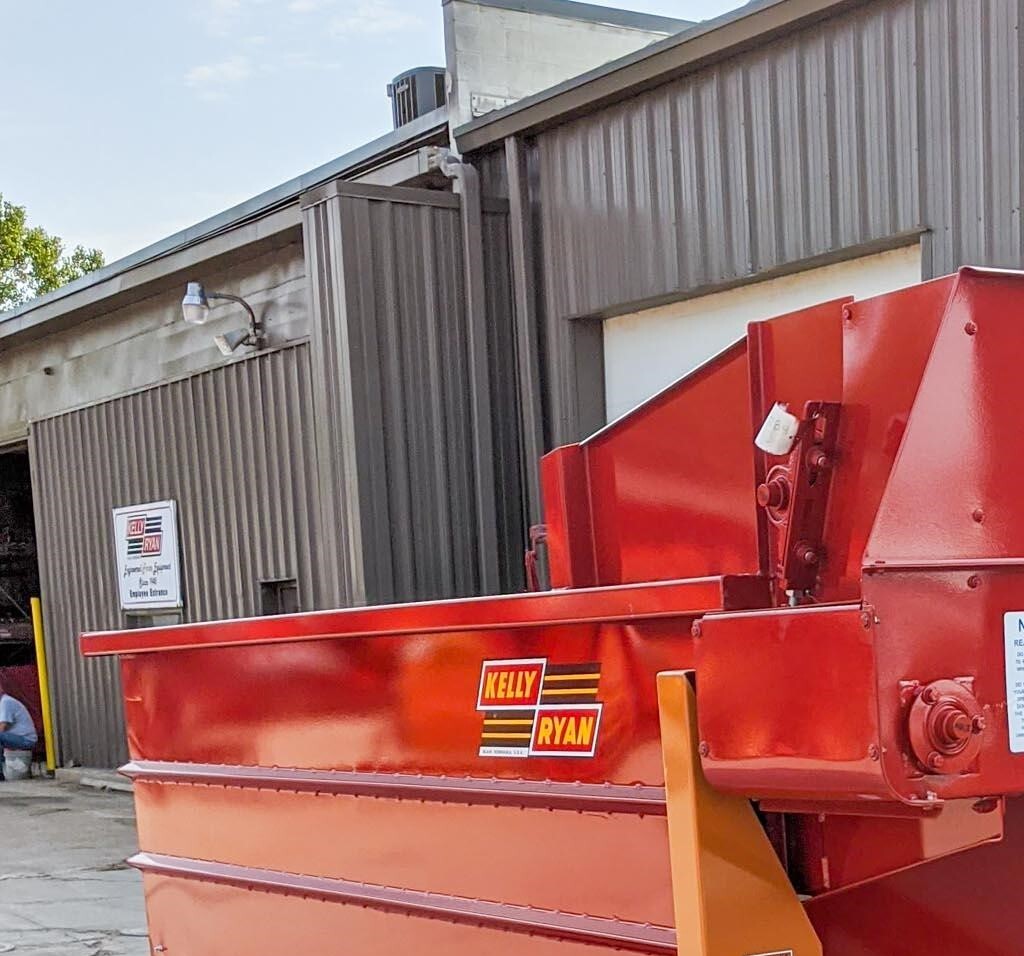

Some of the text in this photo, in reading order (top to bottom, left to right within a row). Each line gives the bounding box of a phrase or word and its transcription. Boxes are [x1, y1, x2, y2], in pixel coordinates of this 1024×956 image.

[144, 536, 161, 552] RYAN
[484, 671, 537, 699] KELLY
[537, 716, 594, 745] RYAN
